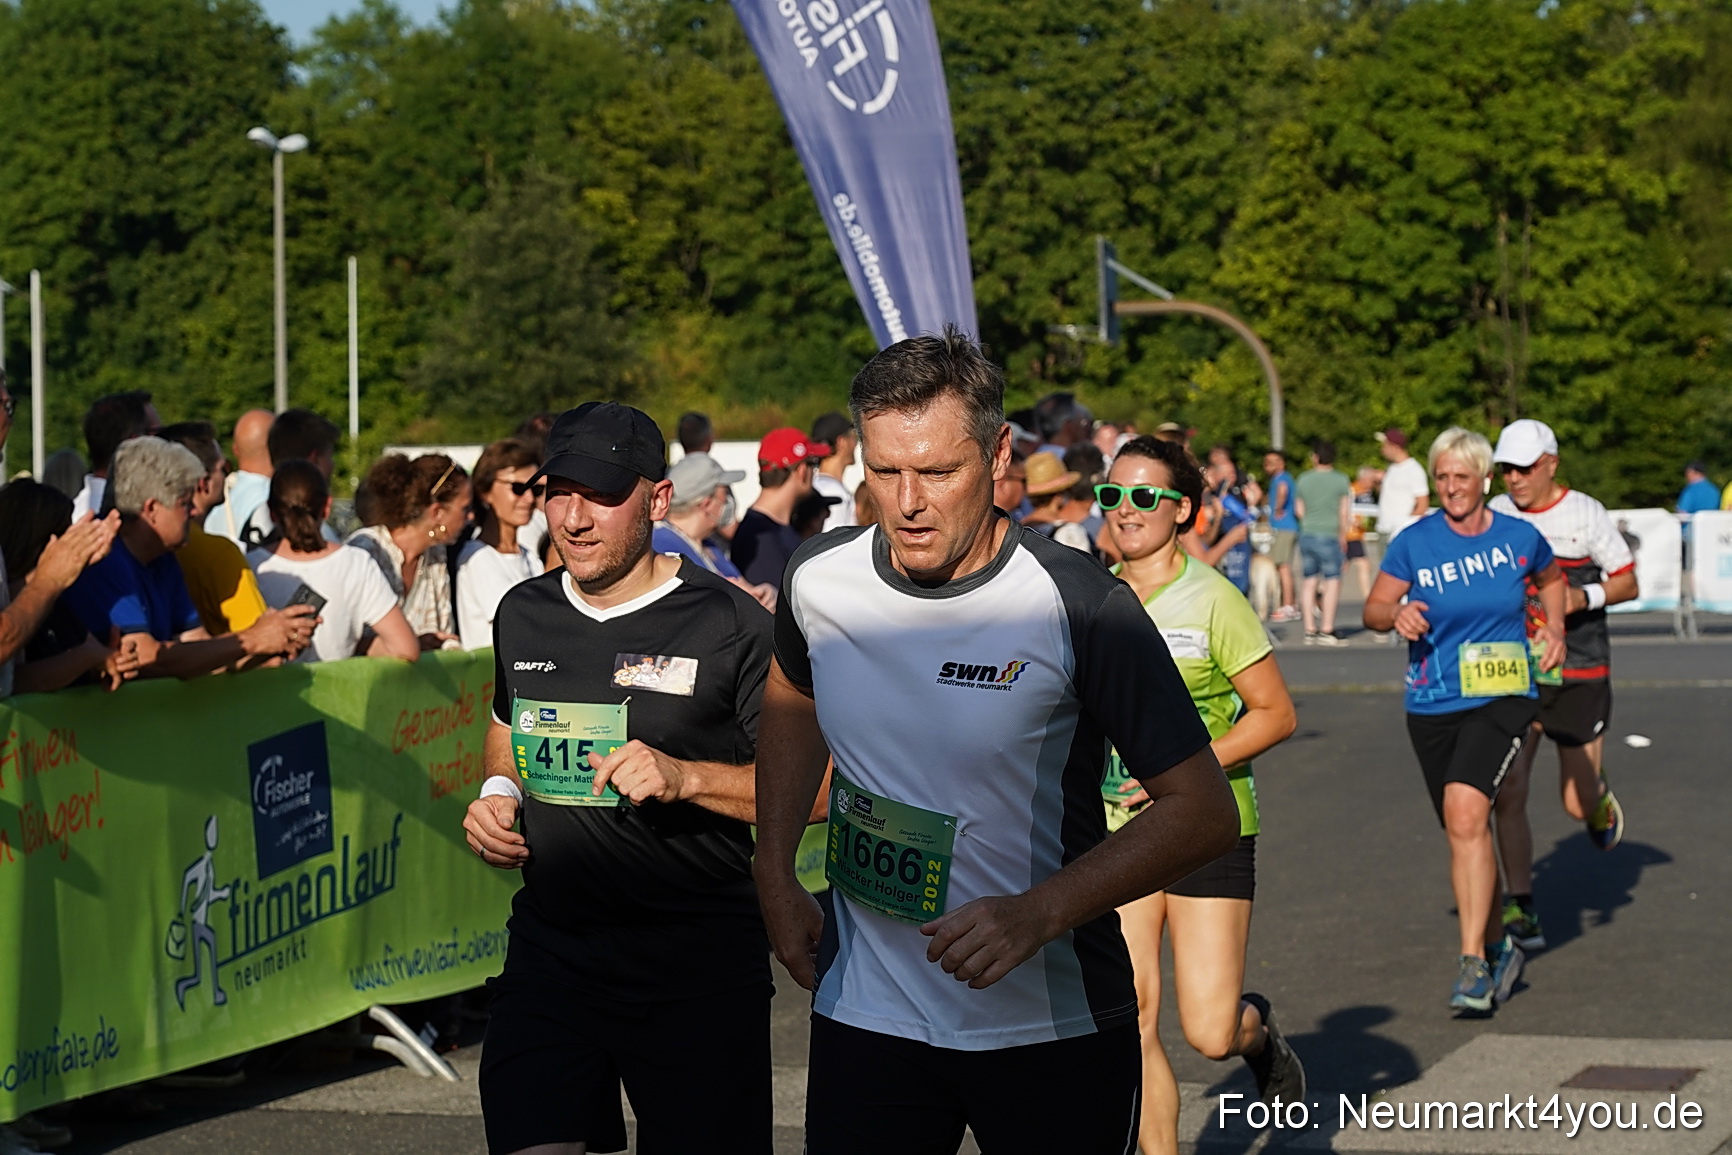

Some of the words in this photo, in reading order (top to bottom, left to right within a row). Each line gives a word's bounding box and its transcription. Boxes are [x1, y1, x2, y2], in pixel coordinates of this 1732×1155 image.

[514, 661, 545, 671] CRAFT
[939, 661, 998, 682] swn
[1473, 659, 1519, 680] 1984
[936, 677, 975, 689] stadtwerke
[975, 683, 1012, 691] neumarkt
[535, 721, 571, 730] Firmenlauf
[516, 745, 529, 780] RUN
[535, 737, 594, 773] 415
[264, 771, 315, 805] Fischer
[527, 770, 573, 784] Schechinger
[848, 804, 886, 826] Firmenlauf
[860, 820, 884, 831] neumarkt
[830, 823, 840, 864] RUN
[841, 820, 923, 885] 1666
[229, 811, 404, 960] firmenlauf
[874, 882, 920, 903] Holger
[922, 859, 942, 913] 2022
[234, 932, 306, 992] neumarkt
[0, 1014, 120, 1096] oberpfalz.de
